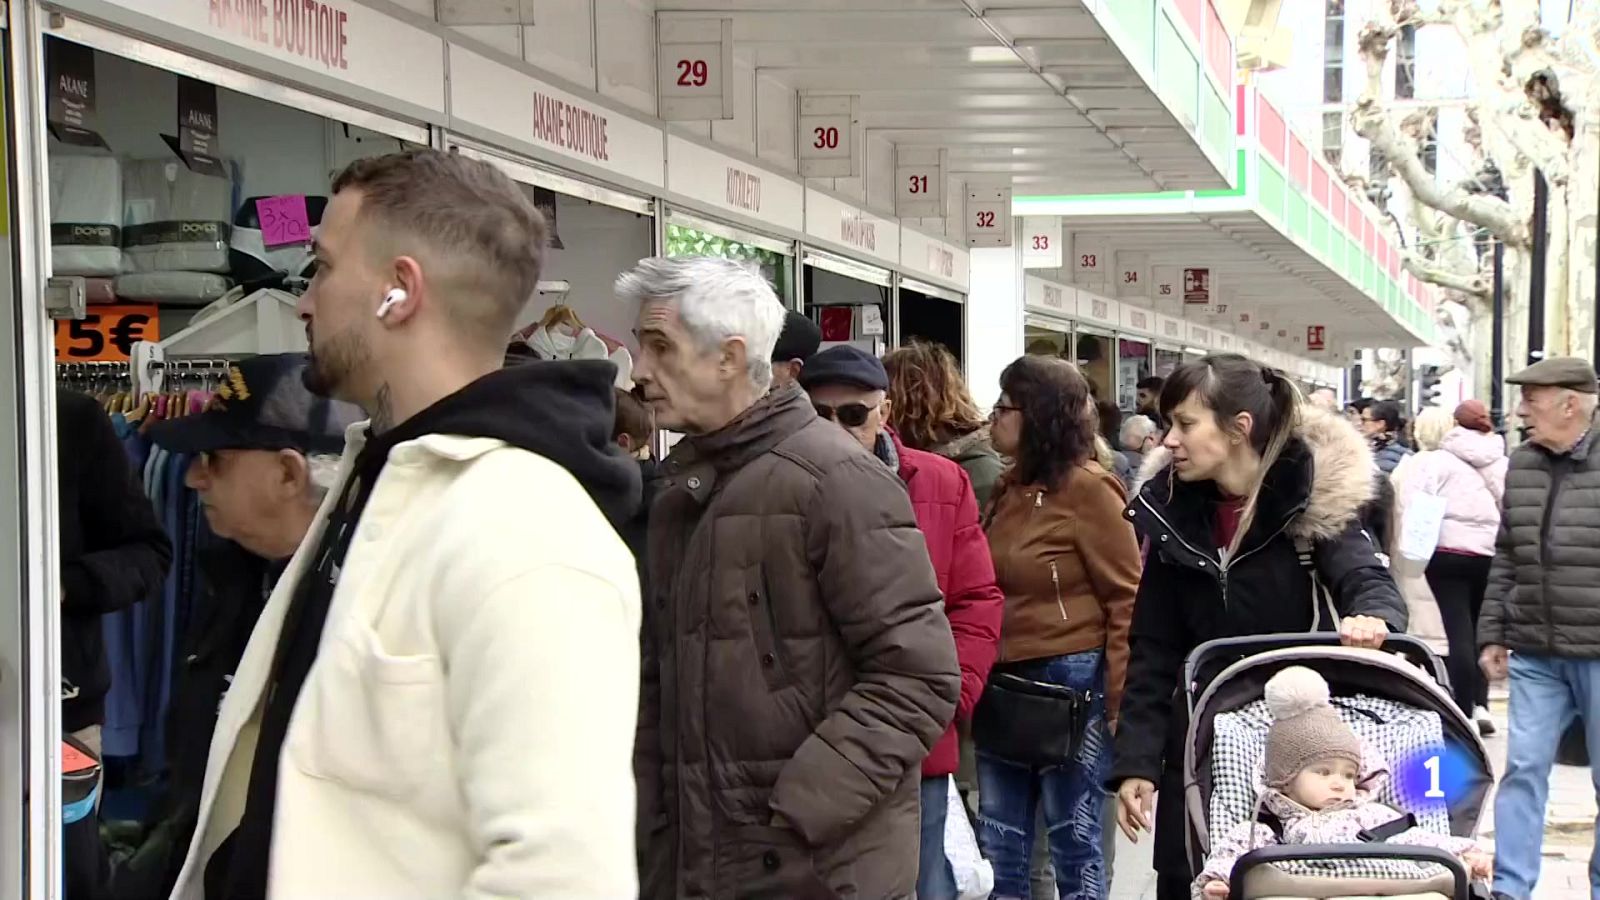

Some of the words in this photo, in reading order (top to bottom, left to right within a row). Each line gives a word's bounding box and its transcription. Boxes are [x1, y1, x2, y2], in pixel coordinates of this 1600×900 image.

[273, 0, 348, 70] BOUTIQUE
[676, 60, 708, 87] 29
[59, 74, 88, 98] AKANE
[188, 108, 213, 130] AKANE
[533, 91, 565, 147] AKANE
[566, 104, 609, 161] BOUTIQUE
[813, 127, 839, 149] 30
[908, 175, 928, 194] 31
[976, 211, 995, 228] 32
[1032, 235, 1049, 250] 33
[1081, 254, 1097, 268] 33
[1124, 271, 1138, 283] 34
[1159, 284, 1171, 295] 35
[1216, 304, 1228, 314] 37
[55, 314, 150, 357] 5€
